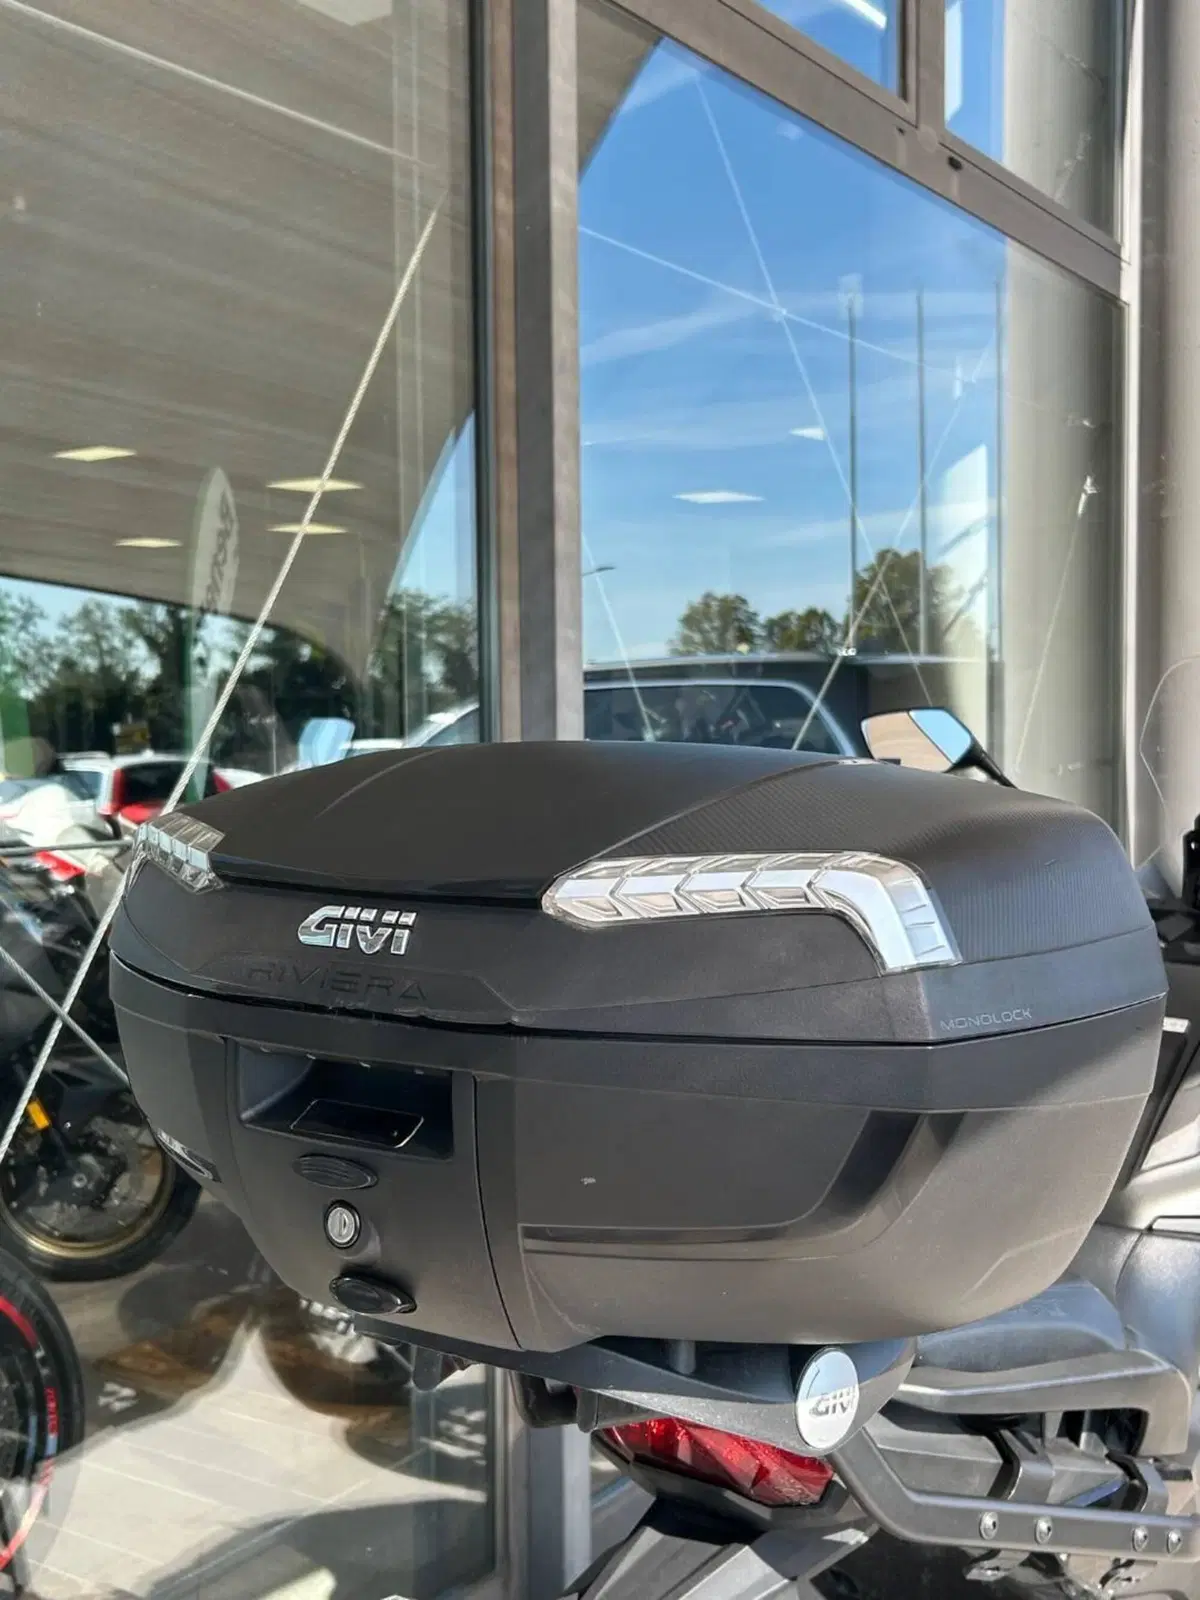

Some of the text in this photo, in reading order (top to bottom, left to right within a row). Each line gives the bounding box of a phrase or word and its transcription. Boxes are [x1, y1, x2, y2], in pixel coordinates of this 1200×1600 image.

[298, 905, 416, 955] GIVI
[248, 961, 427, 1001] RIVIERA
[940, 1008, 1032, 1031] MONOLOCK
